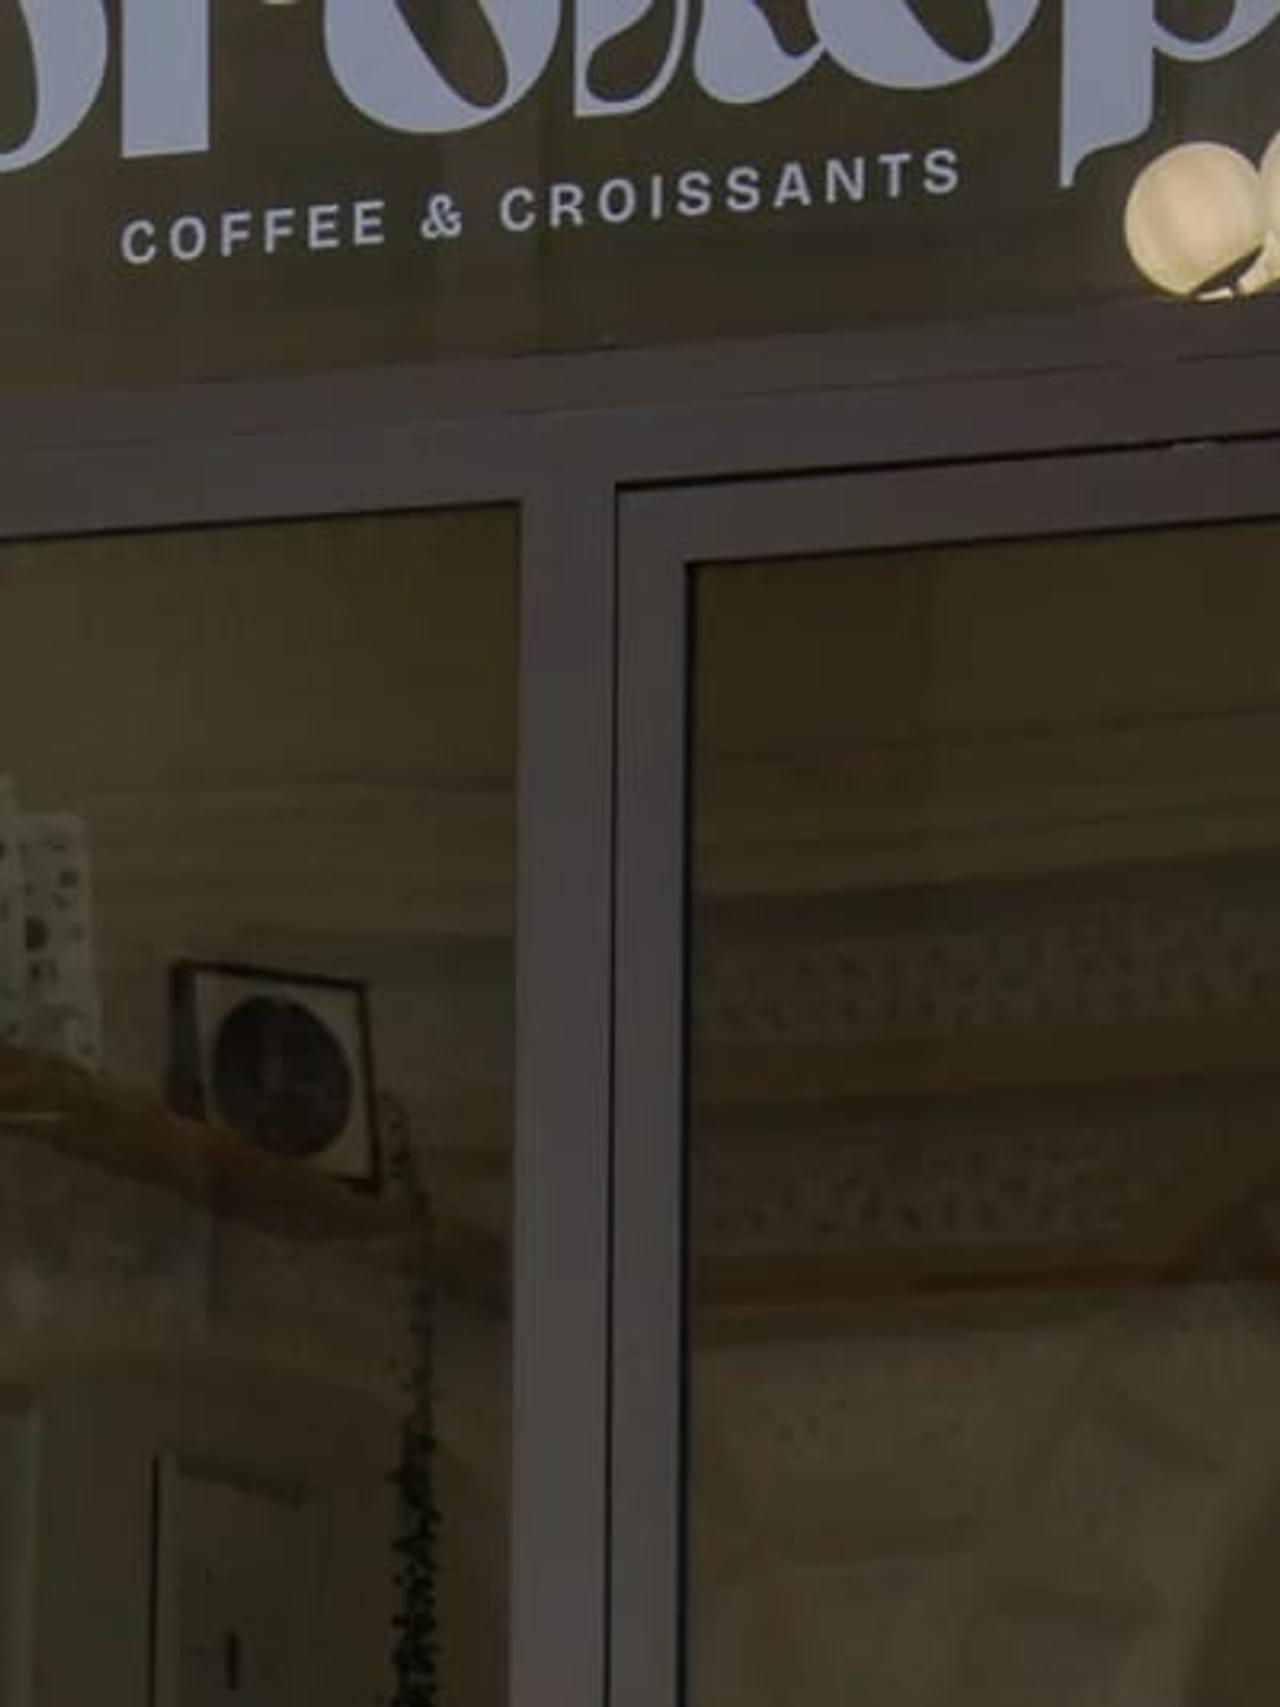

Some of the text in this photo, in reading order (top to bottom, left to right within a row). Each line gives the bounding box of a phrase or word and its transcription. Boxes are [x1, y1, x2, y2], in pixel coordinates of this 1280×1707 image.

[122, 148, 960, 265] COFFEE & CROISSANTS
